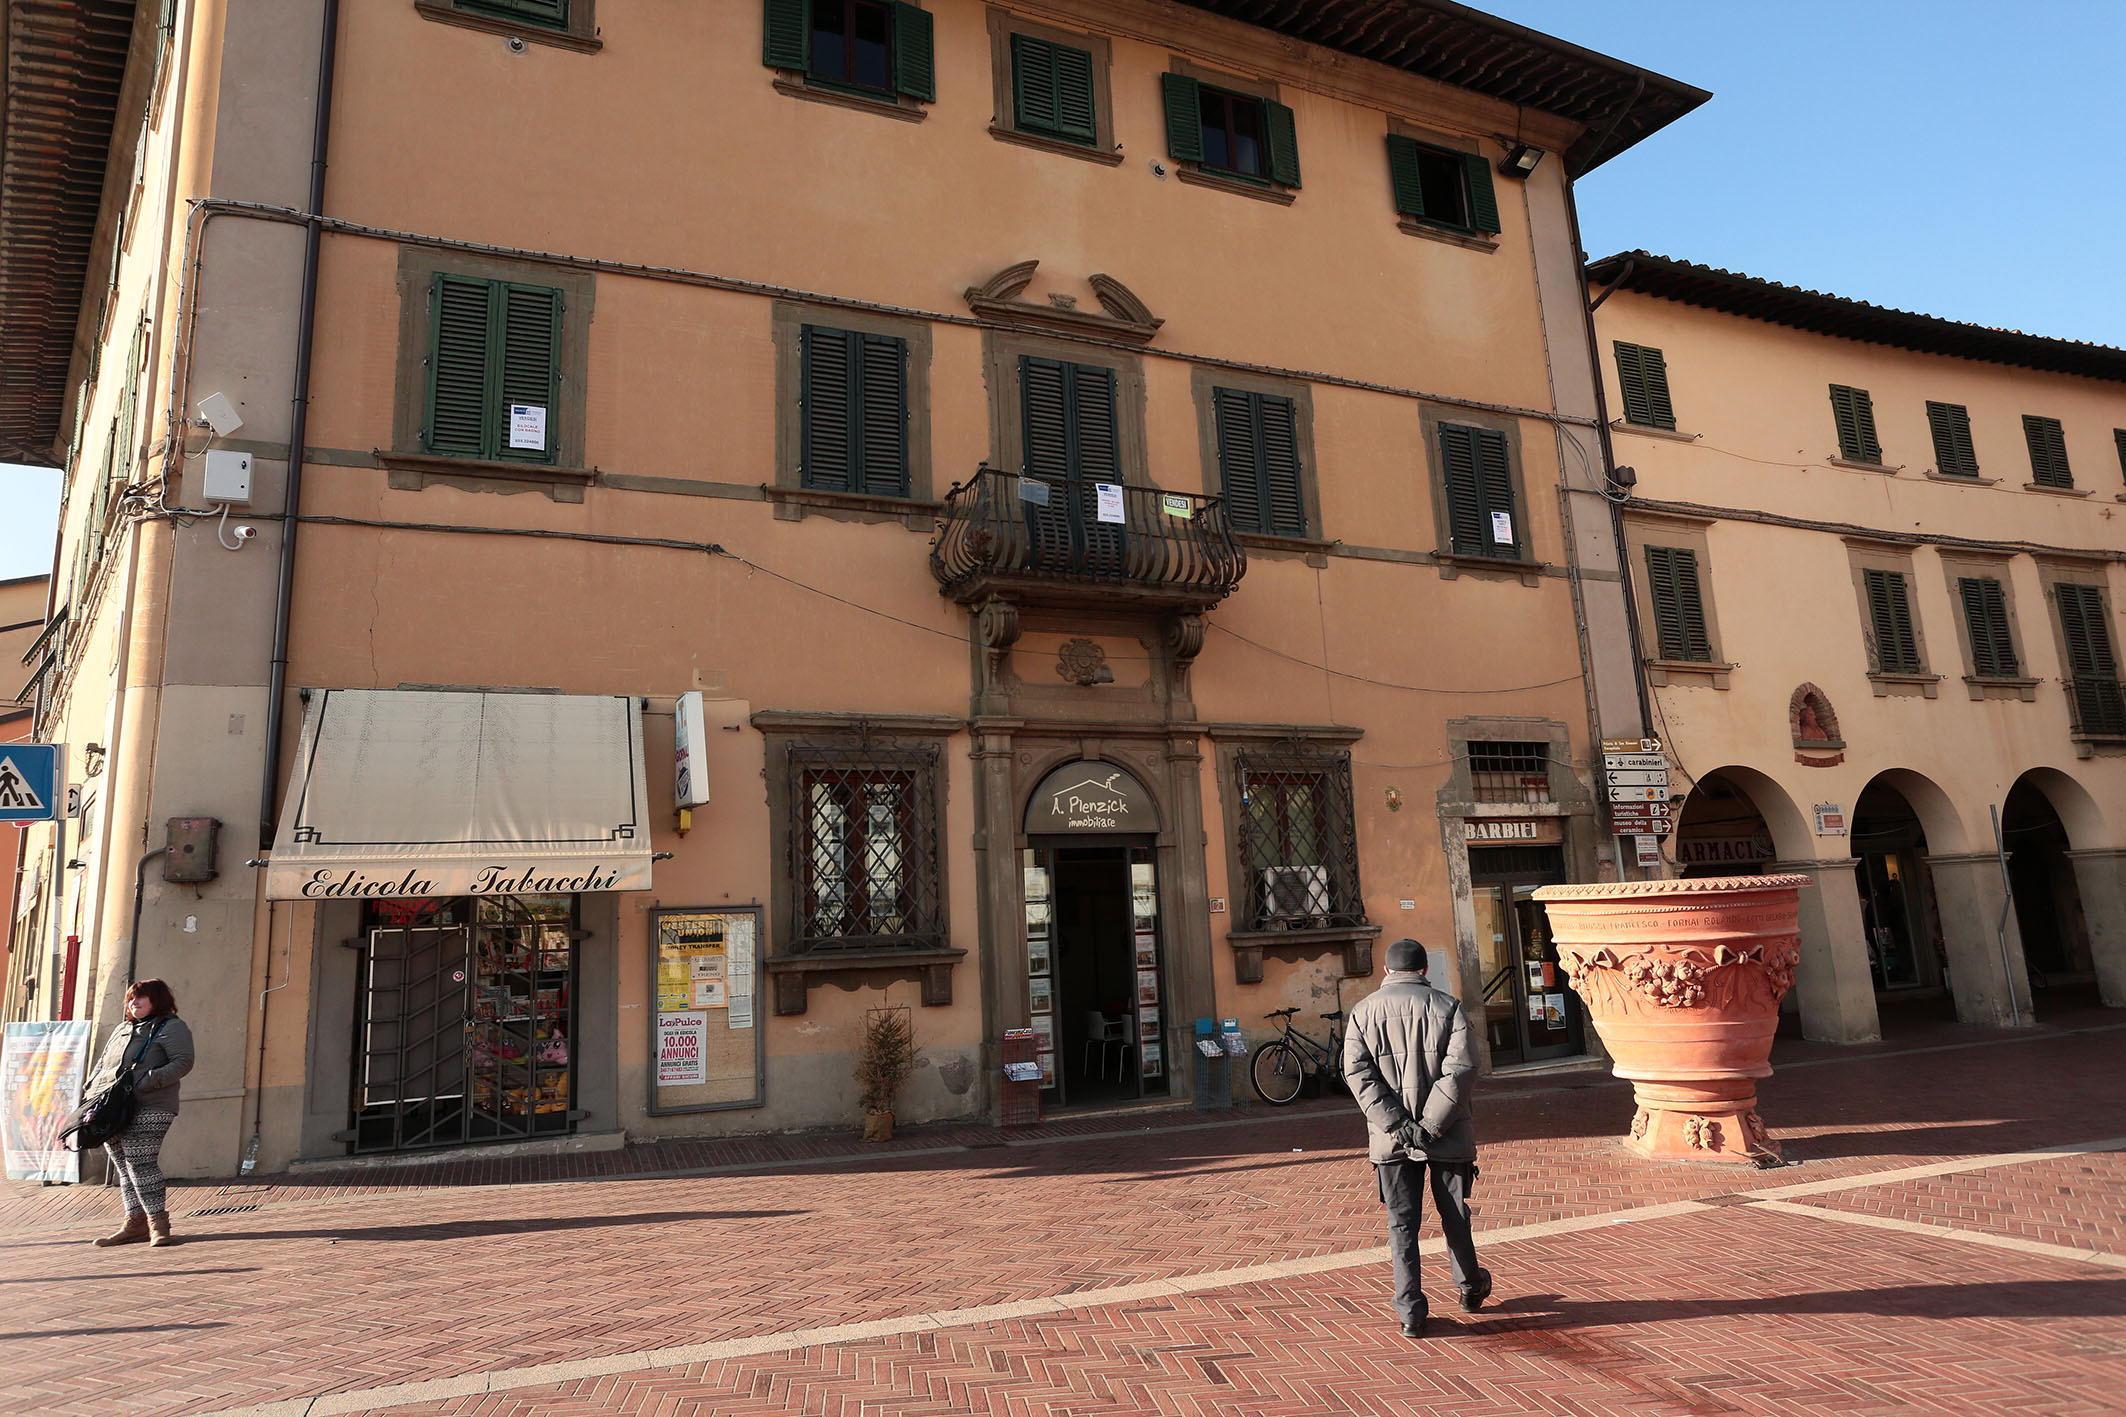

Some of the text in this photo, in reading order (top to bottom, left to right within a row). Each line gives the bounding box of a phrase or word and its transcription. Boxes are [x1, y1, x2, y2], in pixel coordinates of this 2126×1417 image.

[1166, 498, 1187, 507] VENDESI
[1628, 758, 1662, 766] carabinieri
[1051, 796, 1129, 815] A. Plenzick
[1068, 815, 1116, 828] immobiliare
[1682, 838, 1766, 863] ARMACIA
[302, 865, 622, 899] Edicola Tabacchi
[662, 920, 715, 930] WESTERN
[677, 928, 715, 937] UNION
[659, 1017, 702, 1027] La Pulce
[664, 1036, 697, 1047] 10.000
[661, 1047, 699, 1060] ANNUNCI
